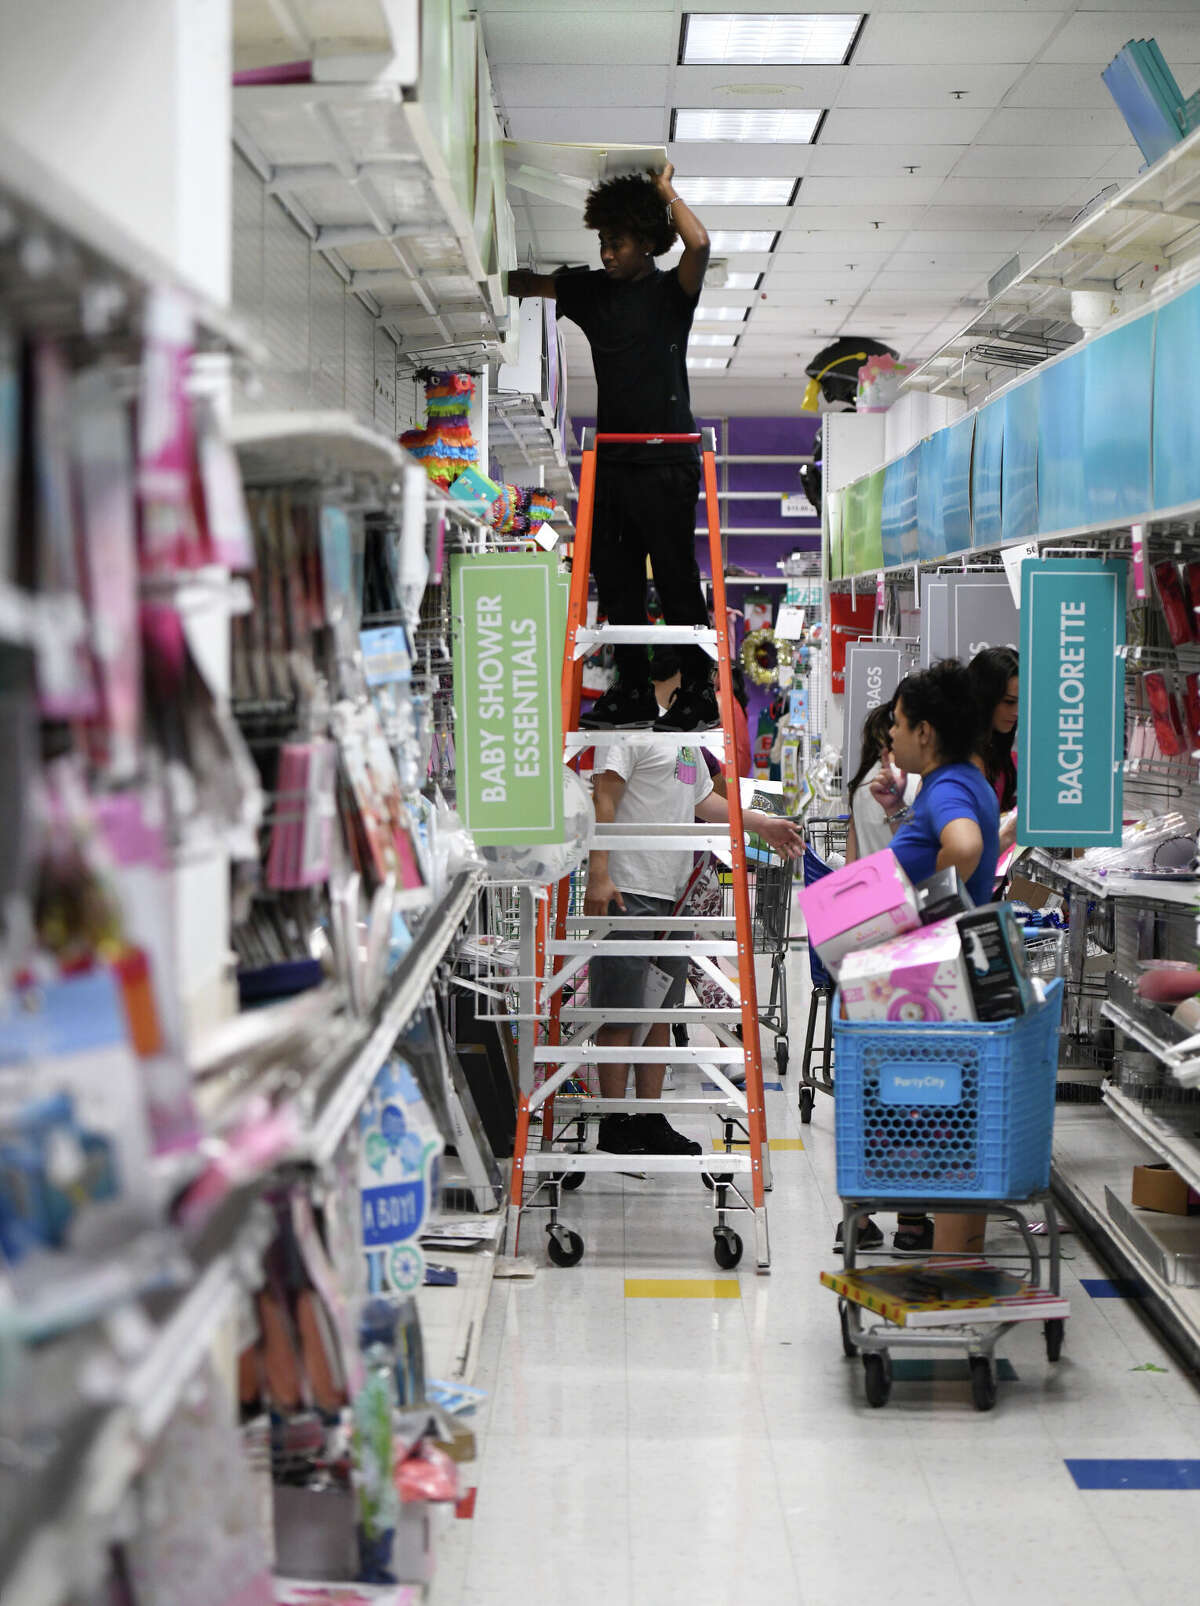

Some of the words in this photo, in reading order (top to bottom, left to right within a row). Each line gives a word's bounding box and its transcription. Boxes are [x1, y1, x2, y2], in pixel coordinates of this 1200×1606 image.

[476, 594, 505, 719] SHOWER
[510, 618, 540, 777] ESSENTIALS
[866, 666, 882, 709] BAGS
[1057, 601, 1086, 804] BACHELORETTE
[480, 729, 506, 802] BABY
